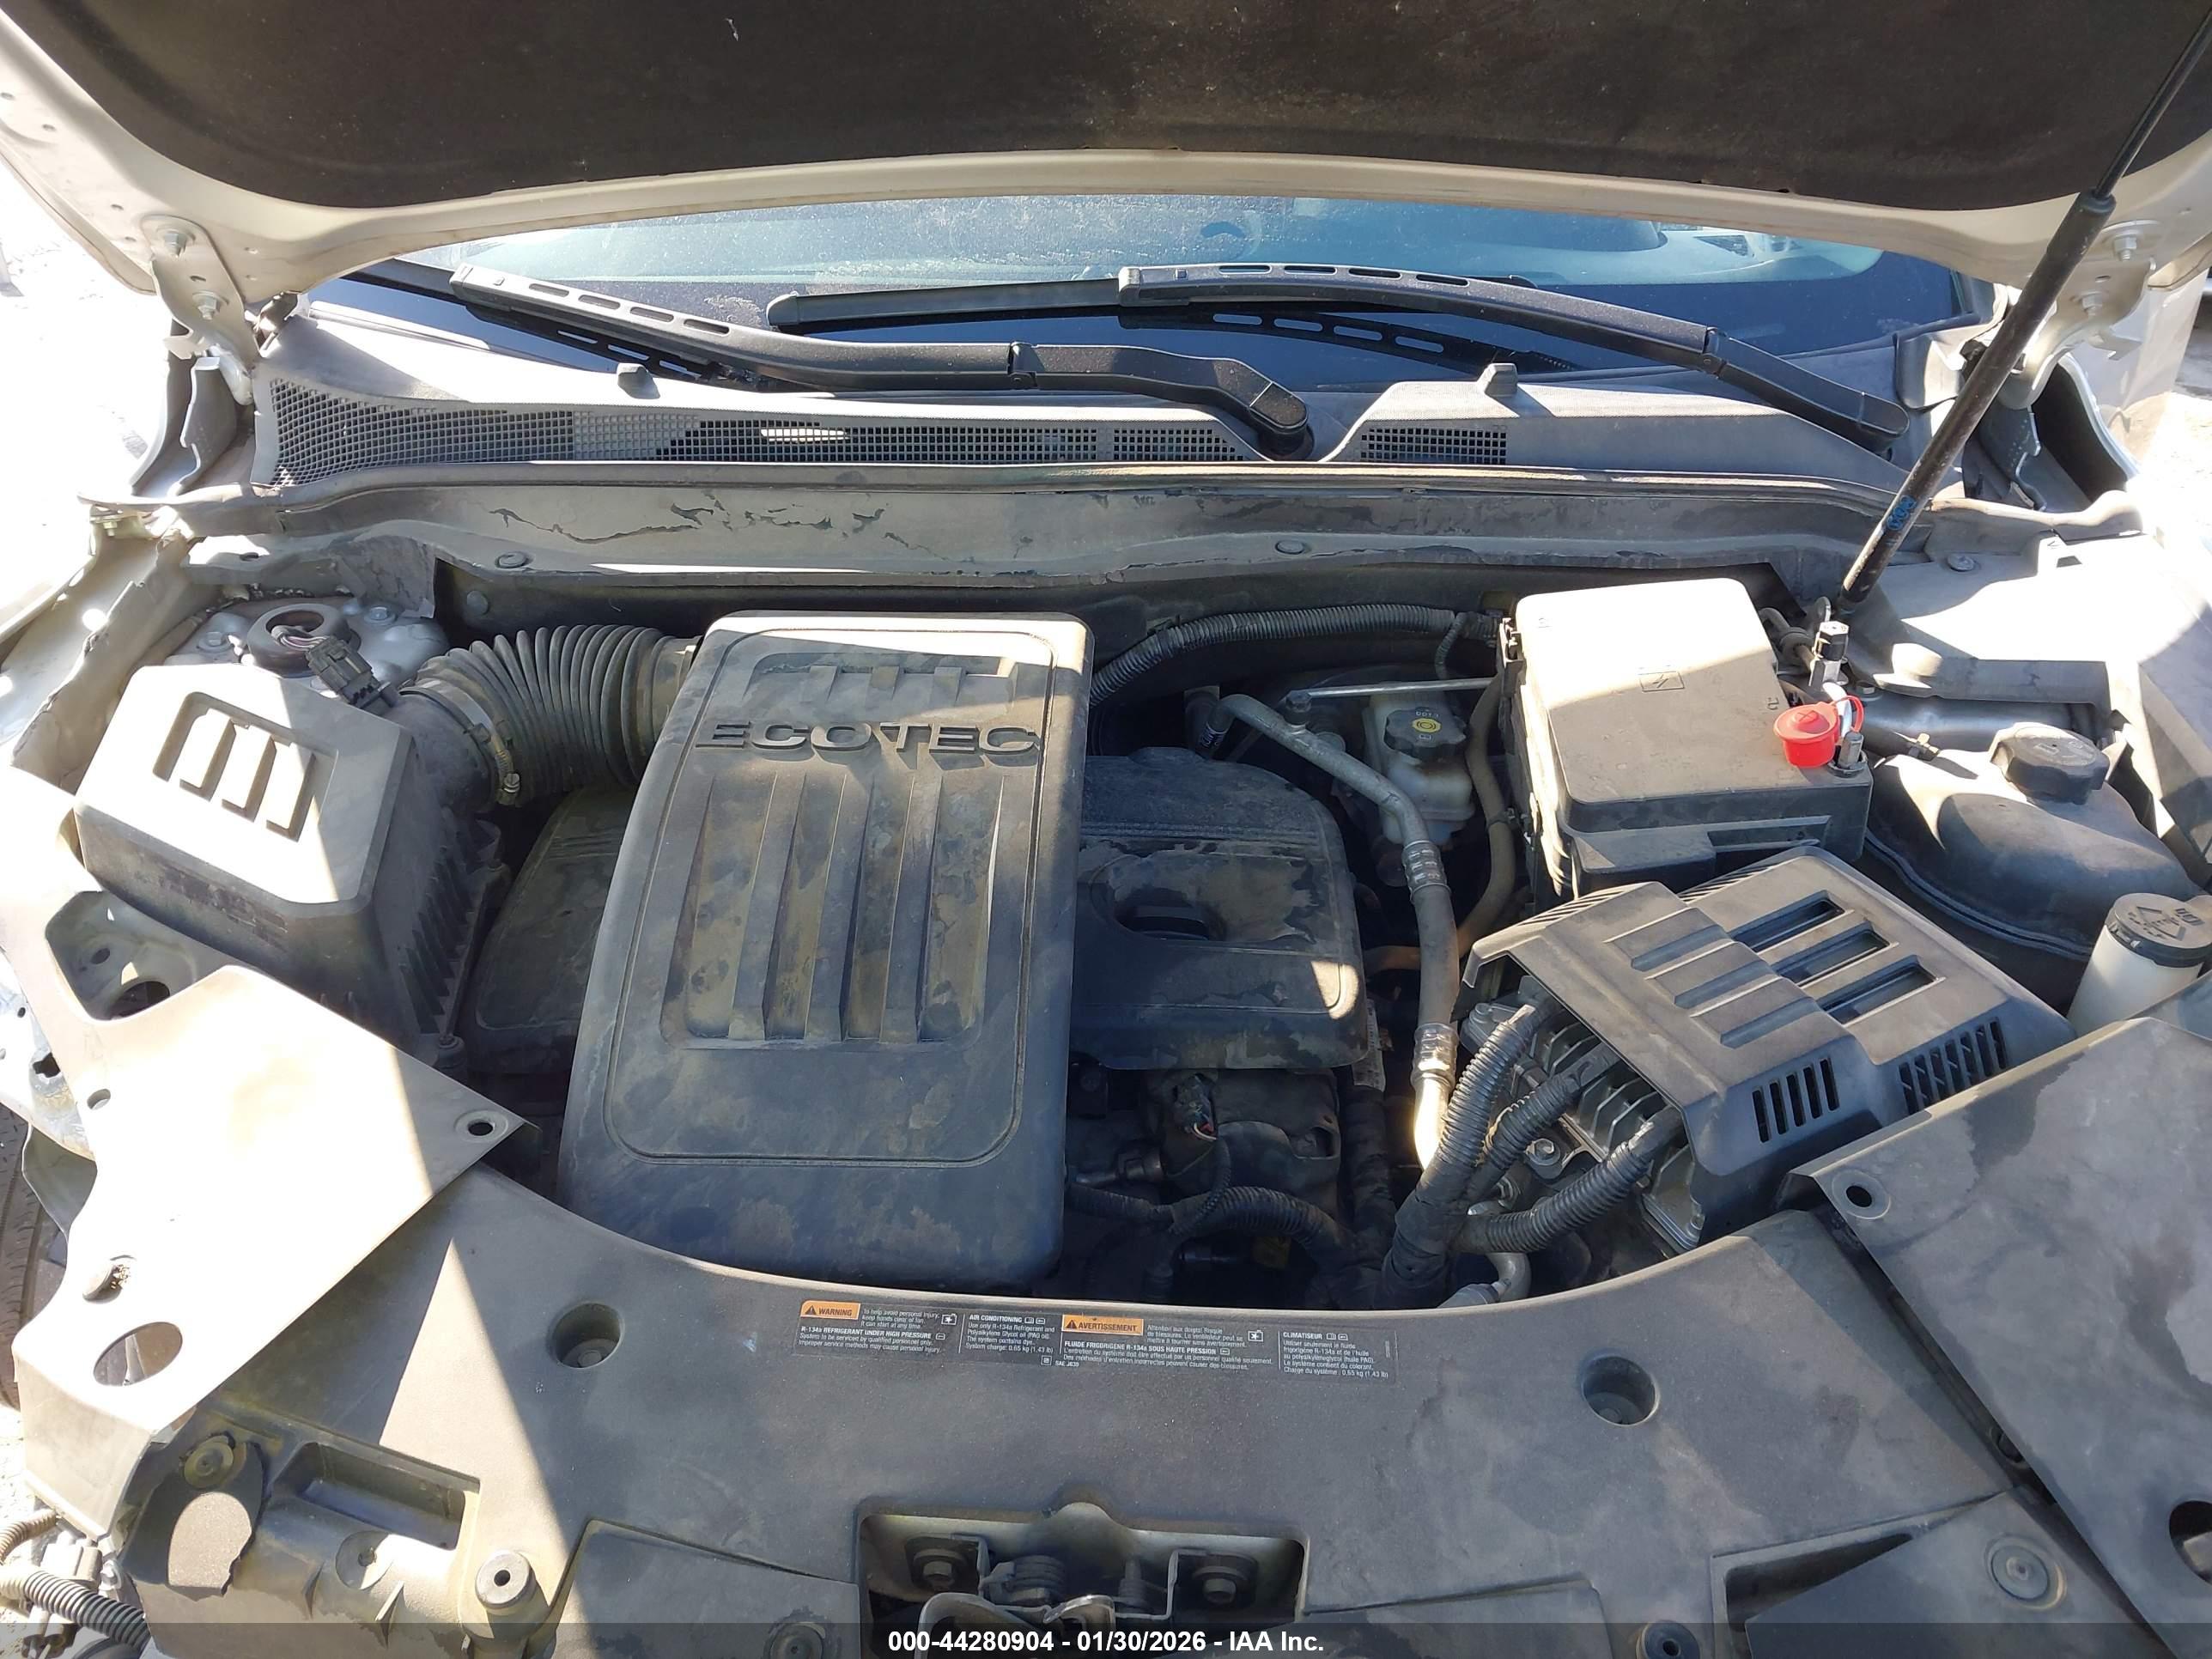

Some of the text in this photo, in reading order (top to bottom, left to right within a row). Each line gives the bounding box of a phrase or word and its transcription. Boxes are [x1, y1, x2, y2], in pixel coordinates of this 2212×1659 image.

[695, 721, 1041, 753] ECOTEC
[819, 1307, 852, 1316] WARNING
[1079, 1322, 1137, 1332] AVERTISSEMENT
